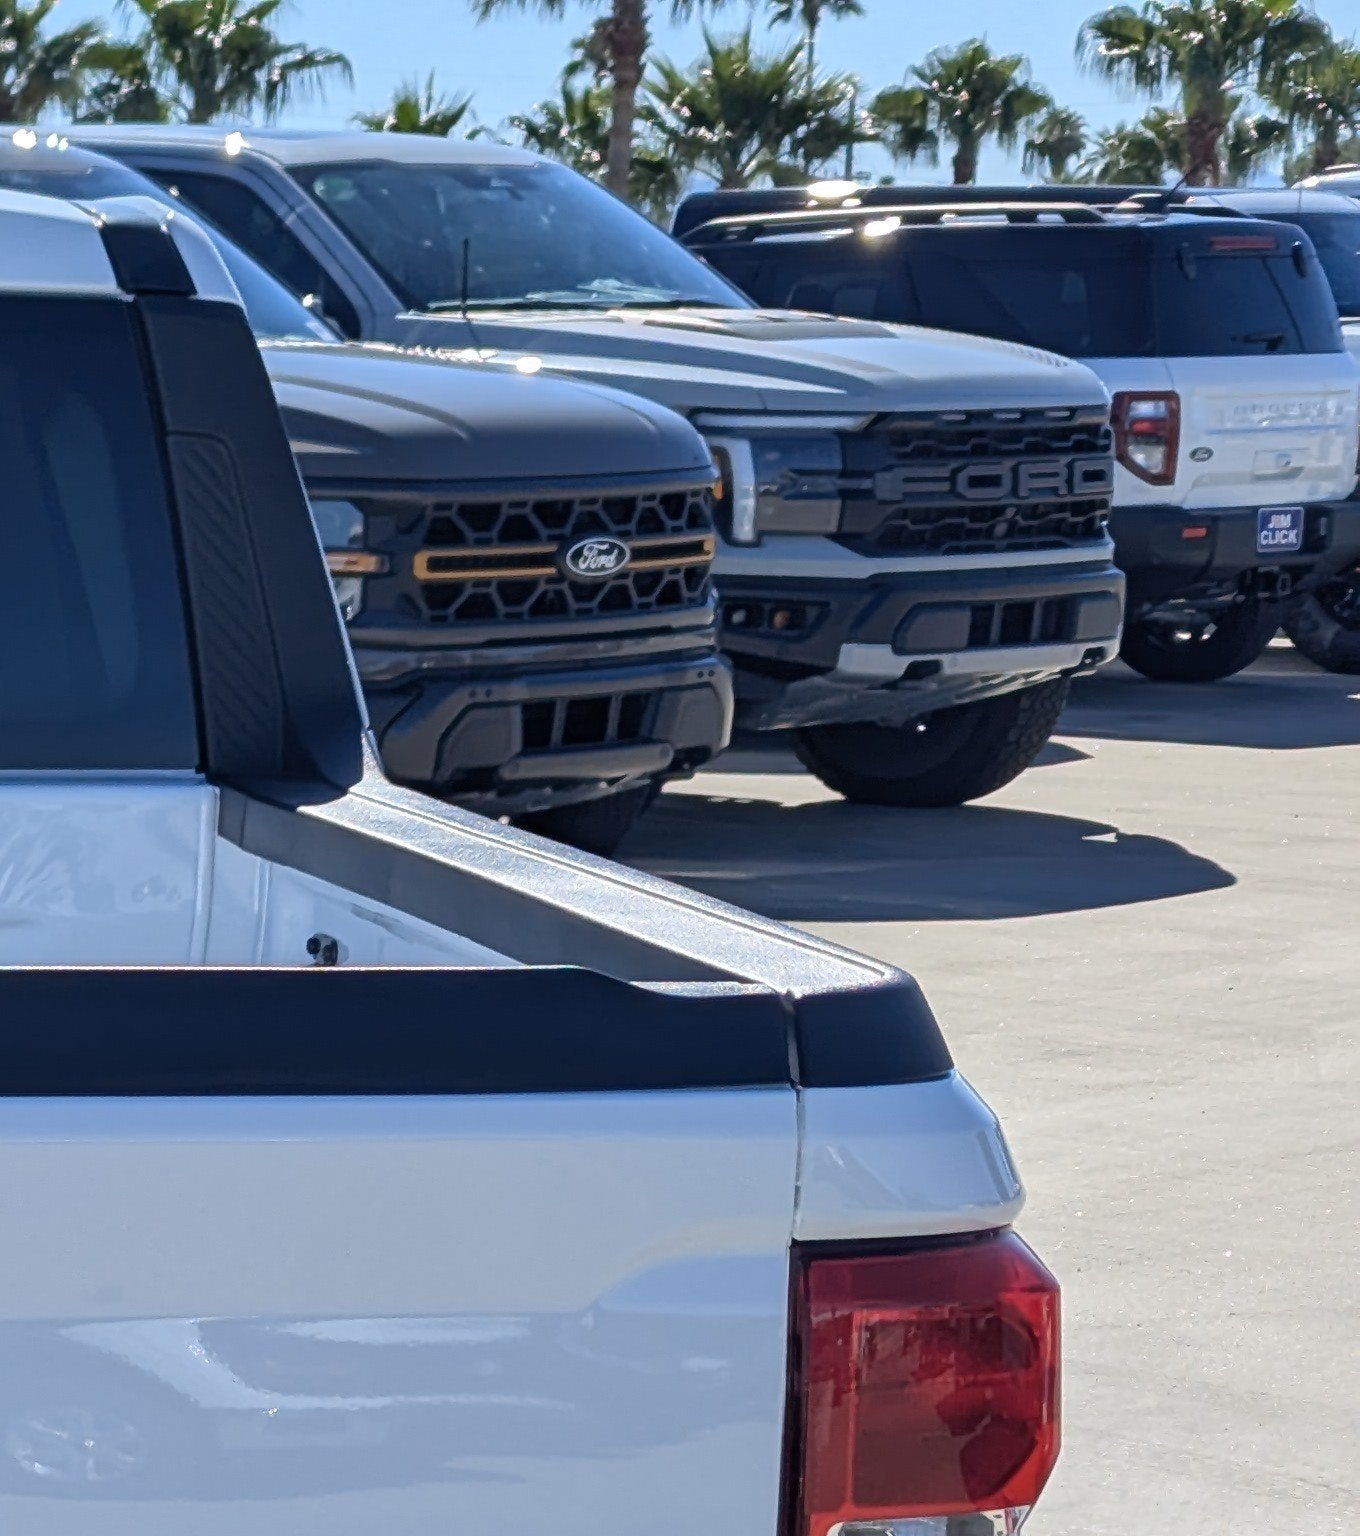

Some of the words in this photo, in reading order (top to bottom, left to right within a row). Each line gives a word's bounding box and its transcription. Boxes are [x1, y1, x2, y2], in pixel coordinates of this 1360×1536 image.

[874, 456, 1114, 501] FORD
[1268, 514, 1292, 528] JIM
[1261, 529, 1298, 545] CLICK
[579, 543, 619, 569] Ford
